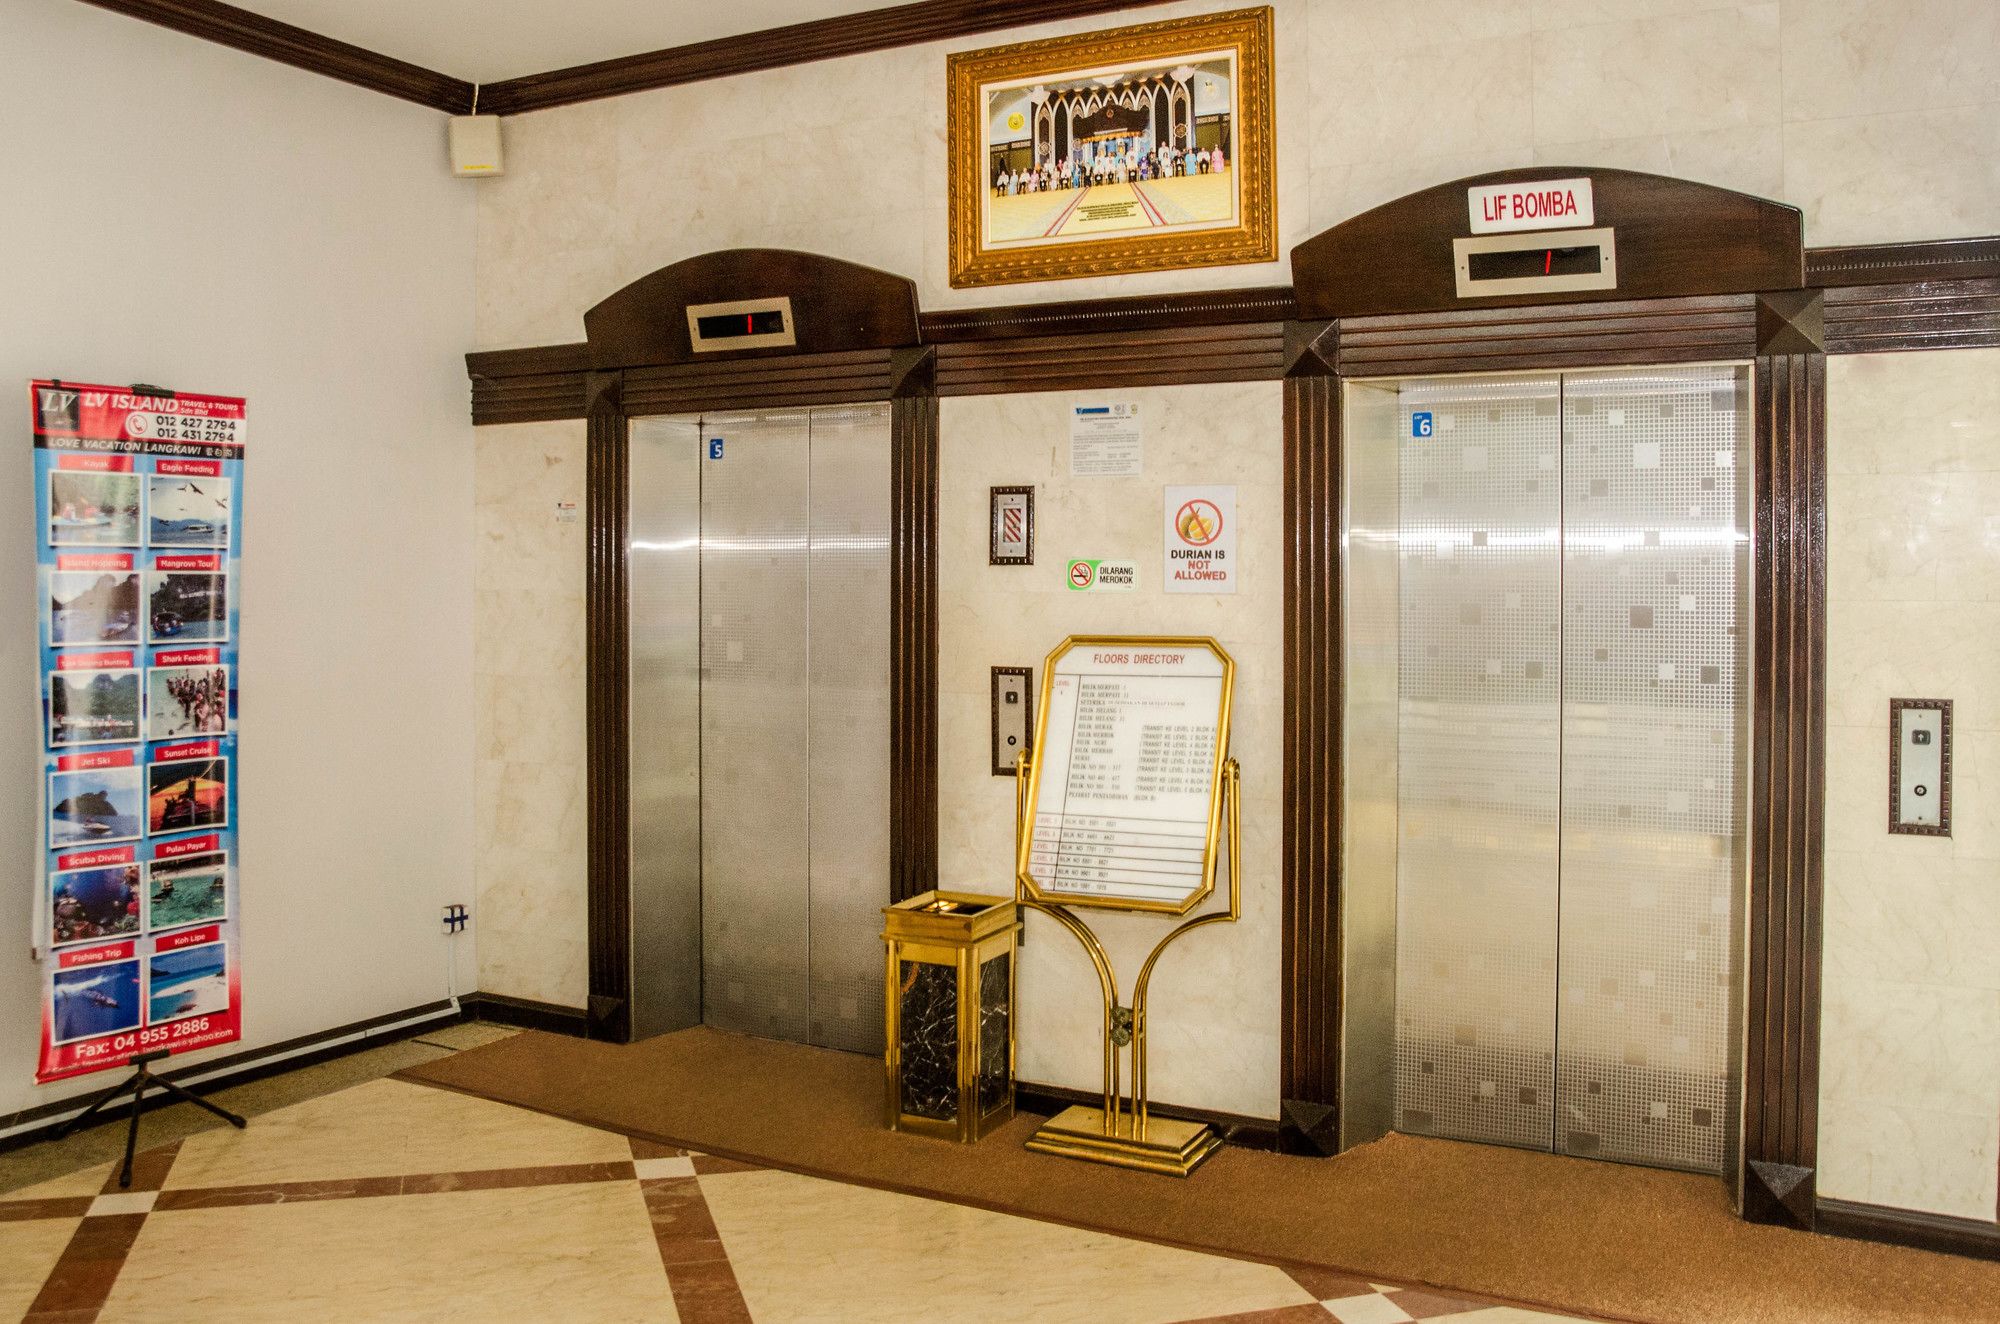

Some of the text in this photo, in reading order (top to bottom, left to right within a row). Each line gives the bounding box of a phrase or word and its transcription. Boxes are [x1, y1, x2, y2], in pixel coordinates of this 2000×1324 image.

[1483, 189, 1578, 222] LIF BOMBA
[41, 391, 78, 412] LV
[84, 392, 179, 413] LV ISLAND
[180, 400, 206, 409] TRAVEL
[215, 402, 239, 411] TOURS
[180, 407, 209, 417] Sdn Bhd
[156, 415, 236, 431] 012 427 2794
[1420, 419, 1431, 435] 6
[157, 428, 234, 442] 012 431 2794
[48, 437, 201, 455] LOVE VACATION LANGKAWI
[715, 444, 722, 458] 5
[161, 464, 215, 475] Eagle Feeding
[1171, 550, 1225, 559] DURIAN IS
[160, 559, 214, 569] Mangrove Tour
[1188, 560, 1211, 570] NOT
[1099, 566, 1133, 576] DILARANG
[1174, 570, 1227, 580] ALLOWED
[1099, 575, 1133, 584] MEROKOK
[162, 653, 214, 664] Shark Feeding
[1093, 653, 1185, 664] FLOORS DIRECTORY
[164, 746, 212, 758] Sunset Cruise
[96, 757, 111, 765] Ski
[166, 841, 207, 854] Pulau Payar
[69, 851, 126, 865] Scuba Diving
[174, 933, 206, 945] Koh Lipe
[72, 949, 122, 964] Fishing Trip
[75, 1018, 210, 1059] Fax: 04 955 2886
